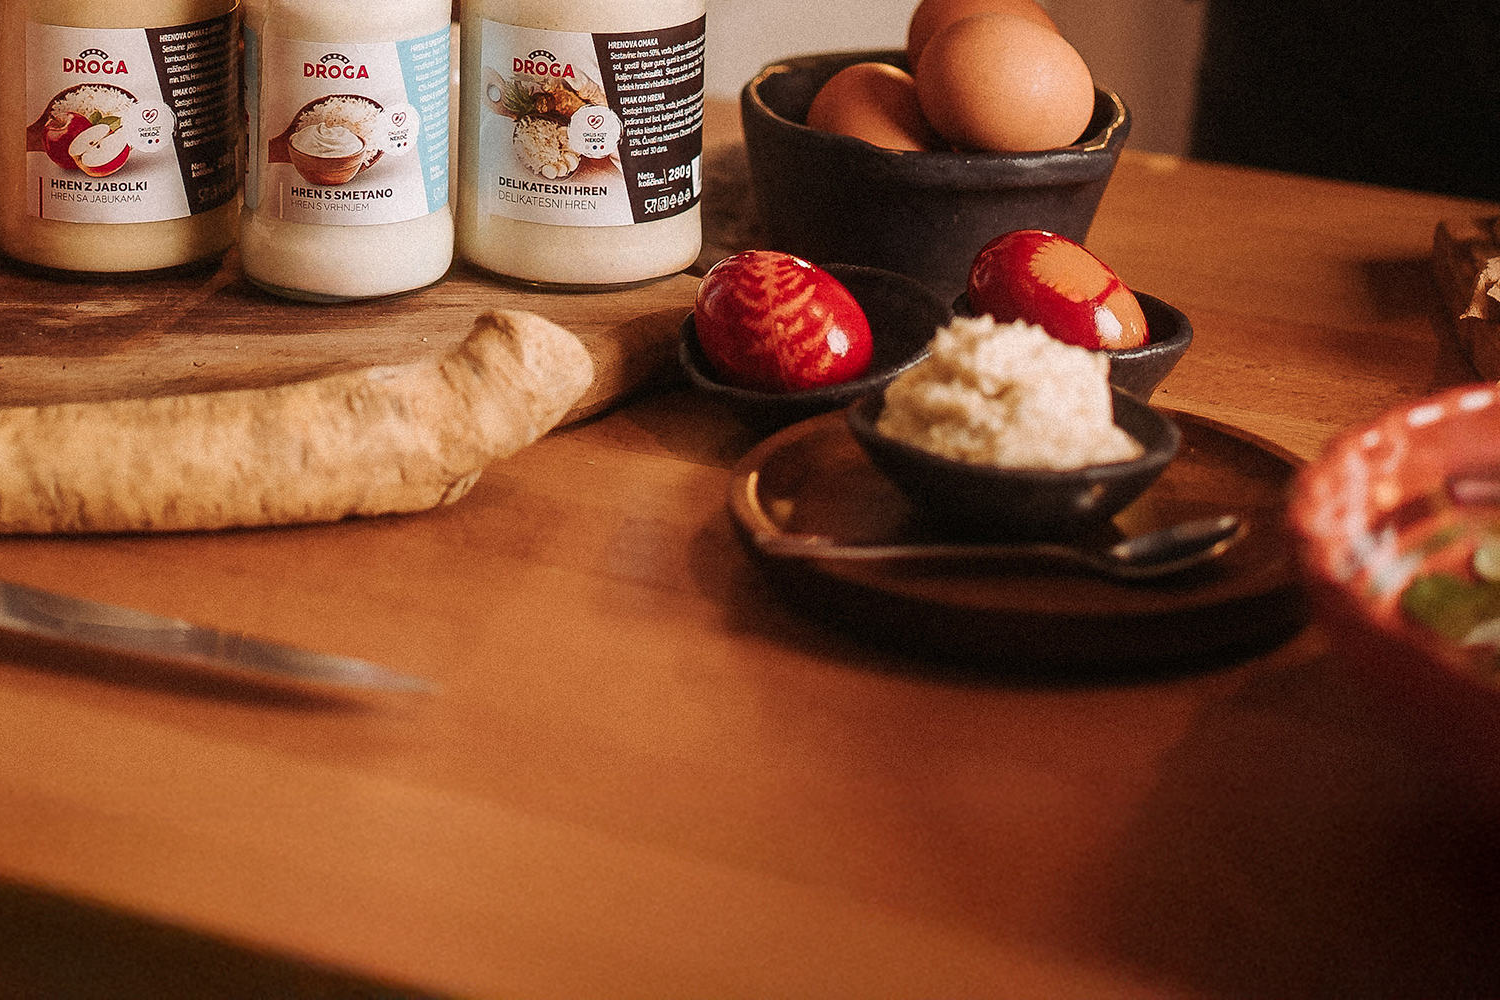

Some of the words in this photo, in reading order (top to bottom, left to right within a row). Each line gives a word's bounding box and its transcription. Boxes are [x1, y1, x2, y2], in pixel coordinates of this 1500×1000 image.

[62, 58, 128, 74] DROGA
[303, 62, 370, 80] DROGA
[513, 58, 575, 78] DROGA
[637, 172, 655, 180] Neto
[51, 179, 82, 190] HREN
[84, 182, 92, 192] Z
[94, 181, 148, 192] JABOLKI
[291, 186, 322, 199] HREN
[324, 190, 332, 200] S
[334, 188, 393, 200] SMETANO
[499, 176, 572, 196] DELIKATESNI
[574, 186, 608, 196] HREN
[50, 191, 75, 202] HREN
[76, 194, 88, 203] SA
[90, 194, 142, 204] JABUKAMA
[498, 190, 563, 208] DELIKATESNI
[565, 200, 597, 210] HREN
[290, 200, 315, 210] HREN
[316, 202, 322, 211] S
[324, 203, 370, 212] VRHNJEM
